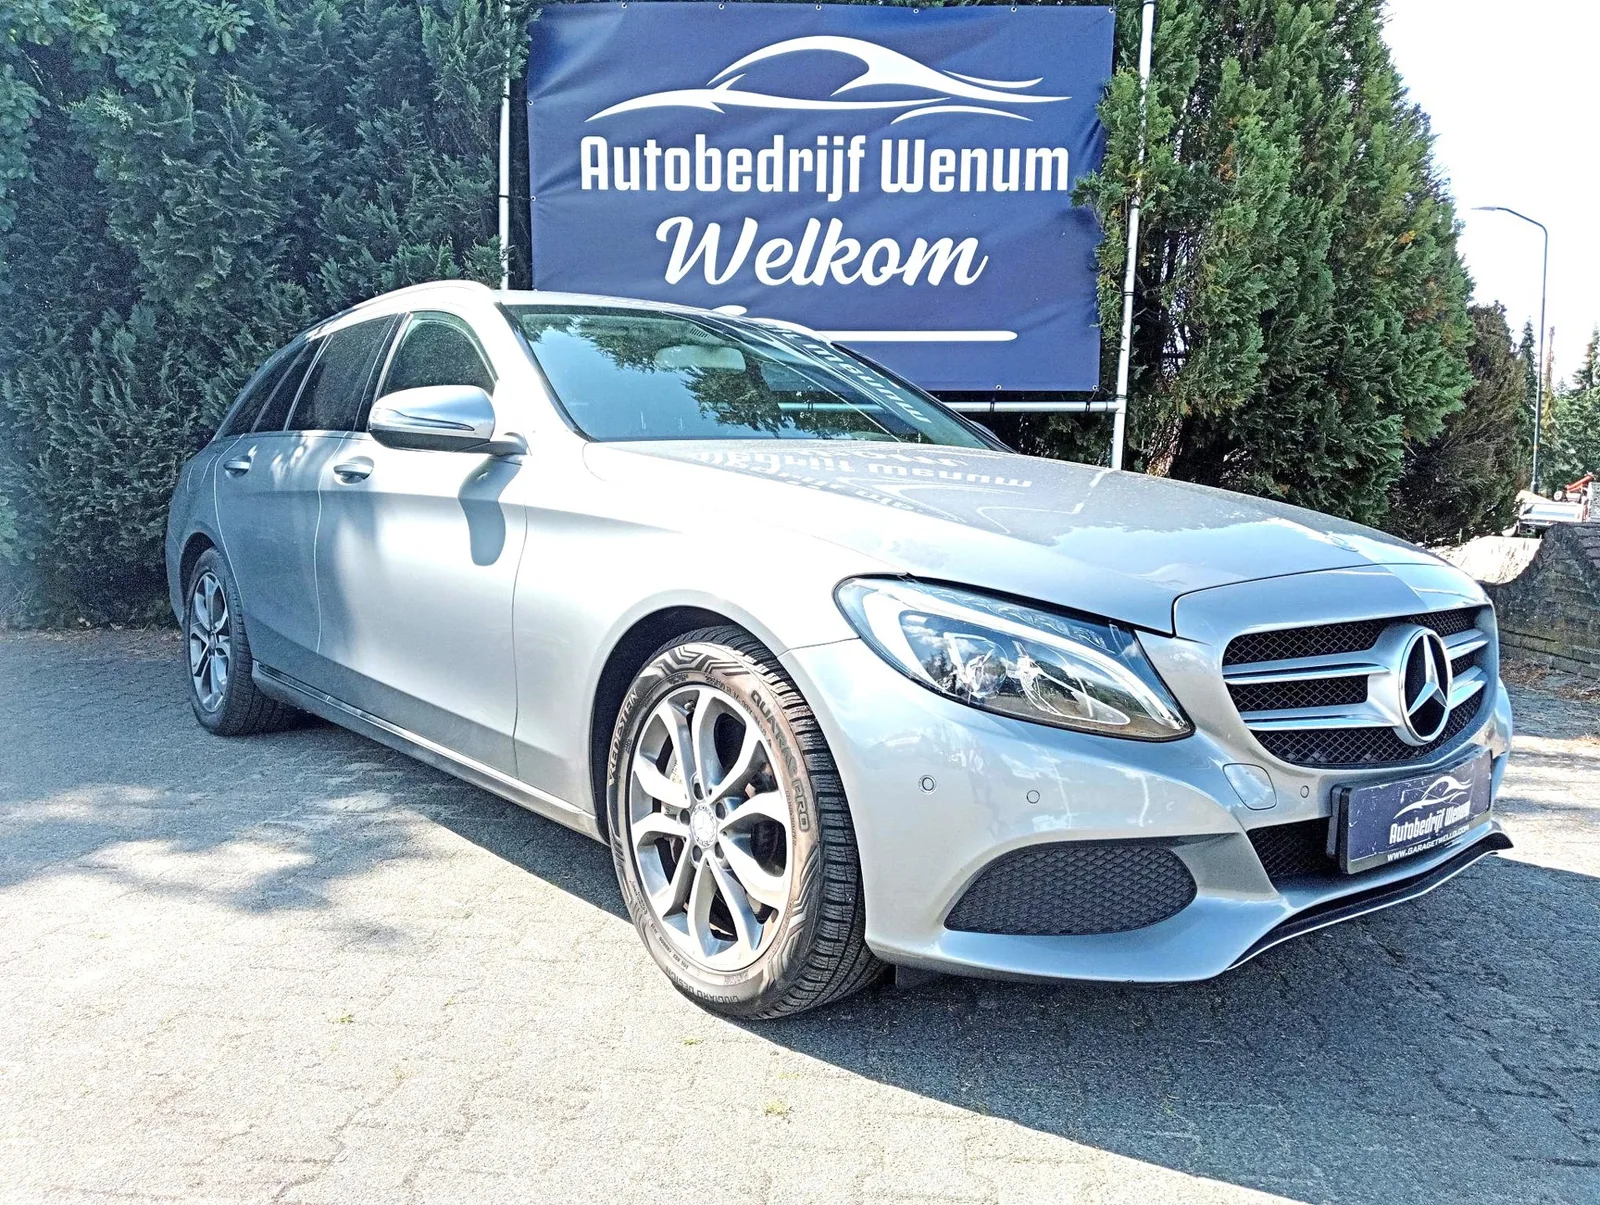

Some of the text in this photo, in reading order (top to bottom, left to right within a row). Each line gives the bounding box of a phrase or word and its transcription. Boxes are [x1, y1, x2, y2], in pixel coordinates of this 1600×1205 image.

[580, 134, 1070, 202] Autobedrijf Wenum
[655, 215, 988, 287] Welkom
[791, 777, 811, 832] PRO
[1388, 807, 1446, 845] Autobedrijf
